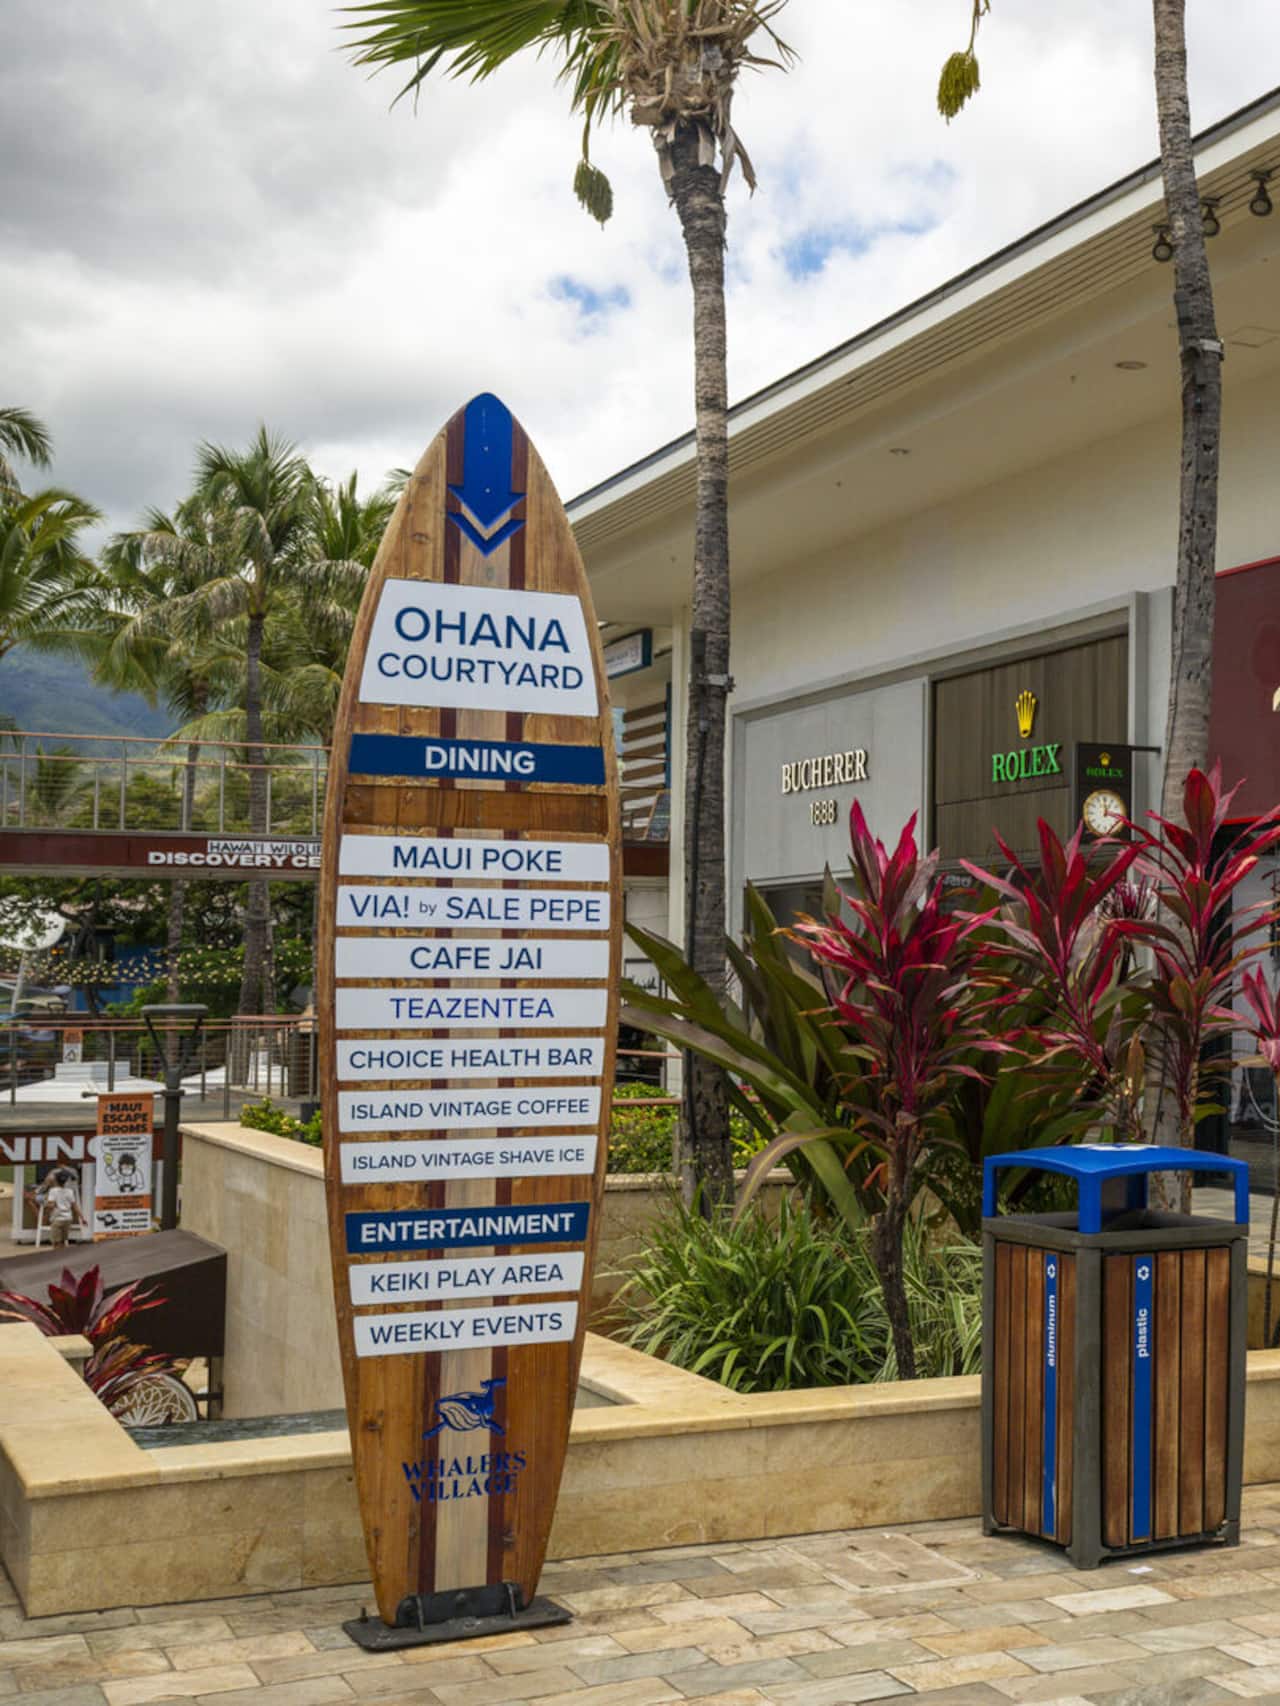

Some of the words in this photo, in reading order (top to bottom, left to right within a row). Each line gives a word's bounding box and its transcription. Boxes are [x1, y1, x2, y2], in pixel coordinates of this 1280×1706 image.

[395, 607, 570, 653] OHANA
[378, 652, 583, 689] COURTYARD
[425, 746, 535, 774] DINING
[782, 749, 868, 793] BUCHERER
[992, 744, 1060, 782] ROLEX
[810, 800, 837, 824] 1888
[148, 852, 287, 868] DISCOVERY
[393, 846, 472, 869] MAUI
[483, 848, 562, 872] POKE
[349, 894, 409, 918] VIA!
[420, 901, 438, 916] by
[446, 897, 520, 920] SALE
[530, 899, 600, 922] PEPE
[410, 947, 490, 970] CAFE
[499, 947, 542, 970] JAI
[390, 998, 555, 1019] TEAZENTEA
[349, 1050, 443, 1069] CHOICE
[451, 1049, 540, 1068] HEALTH
[548, 1048, 593, 1065] BAR
[102, 1113, 148, 1123] ESCAPE
[109, 1103, 143, 1112] MAUI
[351, 1102, 423, 1120] ISLAND
[429, 1101, 511, 1118] VINTAGE
[517, 1099, 590, 1115] COFFEE
[102, 1124, 147, 1133] ROOMS
[352, 1155, 417, 1170] ISLAND
[421, 1151, 494, 1167] VINTAGE
[499, 1149, 554, 1164] SHAVE
[559, 1148, 585, 1162] ICE
[361, 1212, 575, 1243] ENTERTAINMENT
[371, 1271, 430, 1293] KEIKI
[438, 1267, 495, 1288] PLAY
[502, 1264, 564, 1284] AREA
[370, 1320, 464, 1344] WEEKLY
[472, 1313, 563, 1337] EVENTS
[1047, 1294, 1056, 1367] aluminum
[1136, 1308, 1150, 1358] plastic
[402, 1450, 526, 1481] WHALERS
[410, 1472, 518, 1503] VILLAGE
